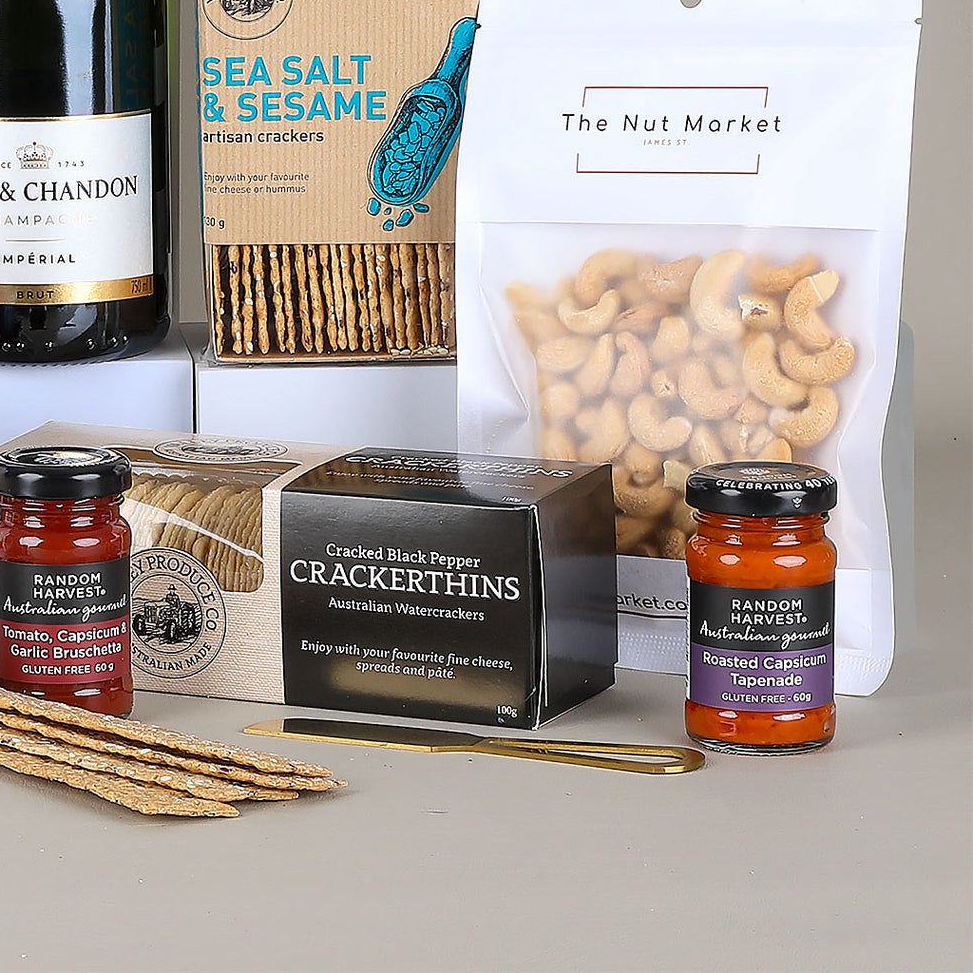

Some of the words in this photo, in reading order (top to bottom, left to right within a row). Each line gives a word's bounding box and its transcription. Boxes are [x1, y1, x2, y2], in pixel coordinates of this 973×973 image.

[202, 56, 272, 87] SEA
[281, 55, 372, 85] SALT
[203, 92, 226, 122] &
[238, 91, 387, 122] SESAME
[562, 113, 608, 132] The
[623, 114, 669, 132] Nut
[684, 114, 781, 132] Market
[203, 130, 253, 144] artisan
[257, 129, 325, 143] crackers
[58, 160, 85, 168] 1743
[204, 172, 225, 183] Enjoy
[227, 173, 245, 182] with
[248, 174, 268, 184] your
[270, 173, 309, 181] favourite
[0, 181, 16, 202] &
[23, 175, 138, 202] CHANDON
[220, 185, 251, 193] cheese
[266, 185, 306, 193] hummus
[218, 219, 225, 229] g
[16, 290, 55, 300] BRUT
[716, 478, 802, 491] CELEBRATING
[805, 478, 822, 489] 40
[326, 543, 384, 561] Cracked
[387, 548, 427, 564] Black
[430, 552, 481, 570] Pepper
[34, 572, 101, 586] RANDOM
[147, 555, 216, 604] PRODUCE
[290, 559, 521, 600] CRACKERTHINS
[4, 596, 81, 615] Australian
[328, 597, 393, 613] Australian
[395, 603, 485, 621] Watercrackers
[732, 599, 802, 611] RANDOM
[3, 625, 53, 644] Tomato,
[57, 626, 119, 643] Capsicum
[121, 621, 127, 633] &
[700, 620, 780, 642] Australian
[10, 644, 48, 659] Garlic
[53, 642, 122, 659] Bruschetta
[130, 643, 183, 671] STRALIAN
[186, 642, 212, 668] MADE
[300, 639, 333, 655] Enjoy
[334, 643, 361, 656] with
[362, 648, 390, 659] your
[391, 648, 445, 664] favourite
[446, 652, 470, 667] fine
[471, 655, 514, 672] cheese,
[21, 665, 62, 675] GLUTEN
[65, 665, 91, 674] FREE
[356, 660, 401, 675] spreads
[402, 665, 426, 677] and
[427, 667, 457, 680] pâté.
[703, 651, 759, 669] Roasted
[763, 654, 827, 671] Capsicum
[730, 672, 803, 689] Tapenade
[721, 692, 759, 703] GLUTEN
[761, 694, 786, 703] FREE
[793, 692, 812, 702] 60g
[496, 705, 518, 718] 100g
